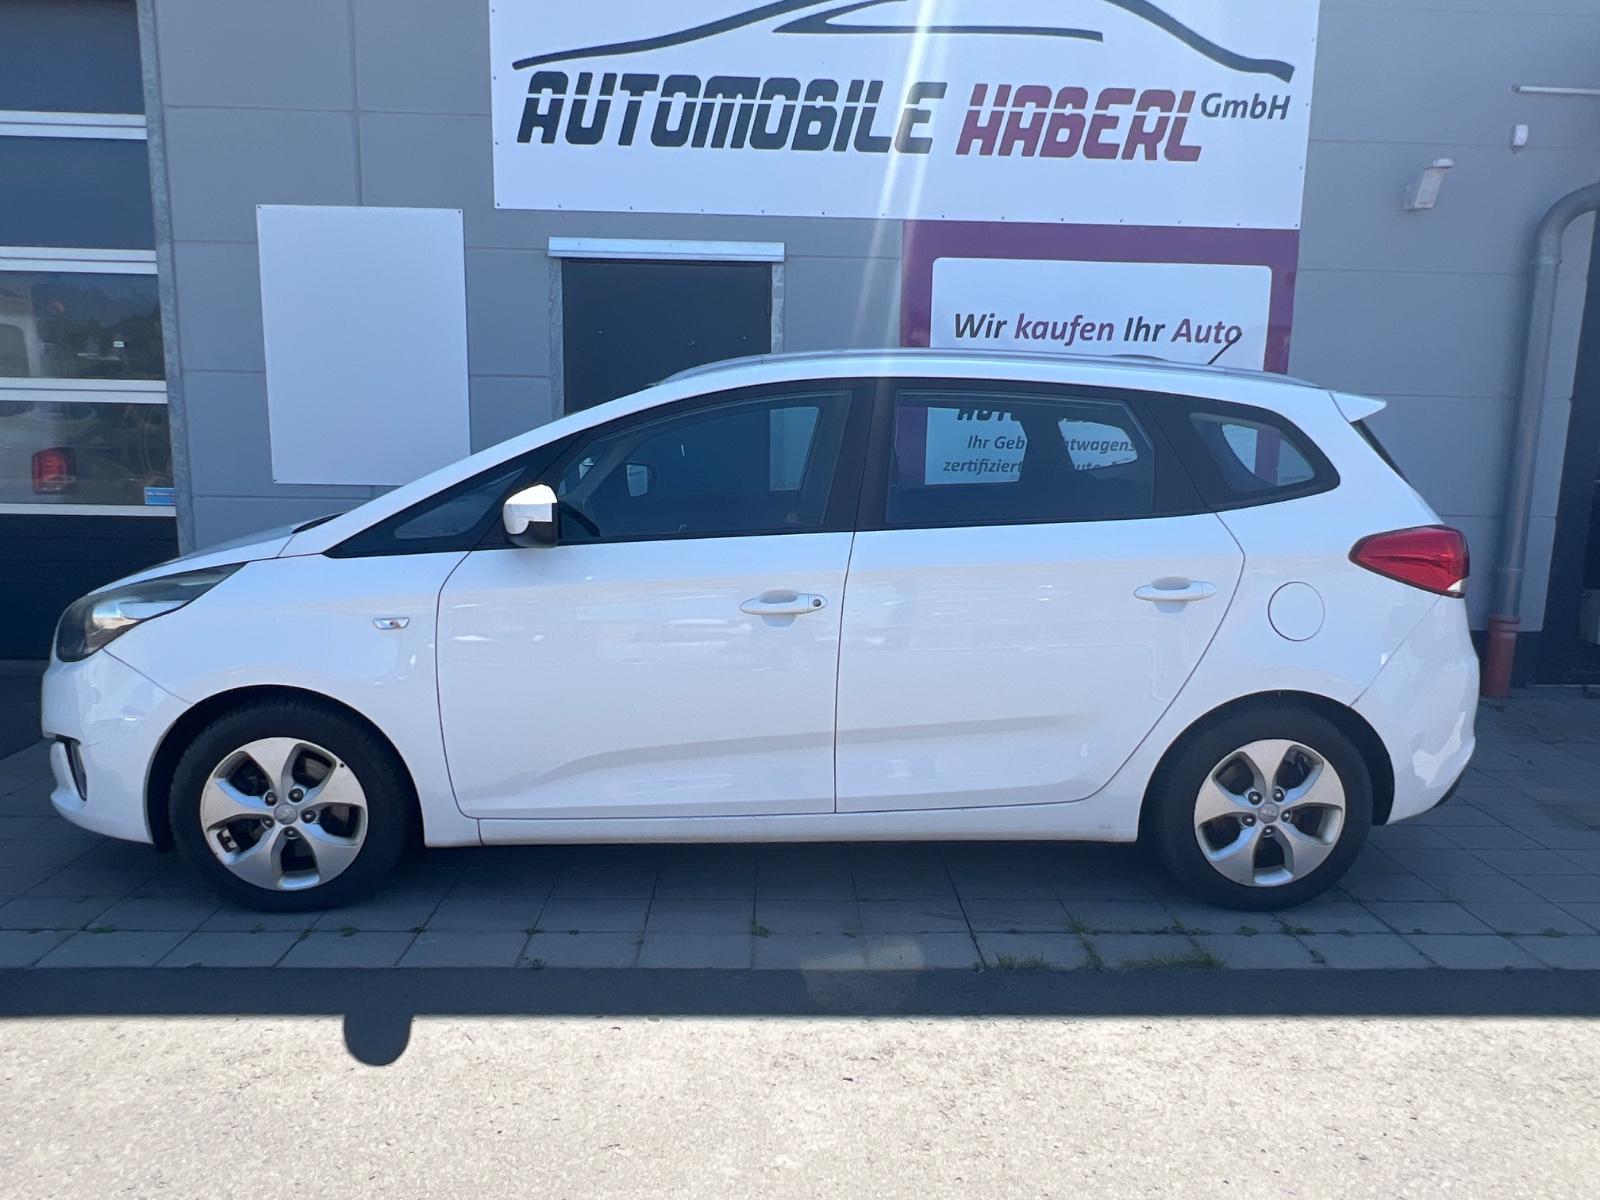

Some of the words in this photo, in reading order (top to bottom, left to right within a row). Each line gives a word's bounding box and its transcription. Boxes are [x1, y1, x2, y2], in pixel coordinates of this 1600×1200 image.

[517, 71, 947, 154] AUTOMOBILE
[955, 83, 1202, 162] HABERL
[1201, 93, 1291, 120] GmbH
[954, 313, 1008, 339] Wir
[1014, 313, 1114, 347] kaufen
[1123, 316, 1166, 342] Ihr
[1170, 318, 1243, 344] Auto
[967, 435, 990, 449] Ihr
